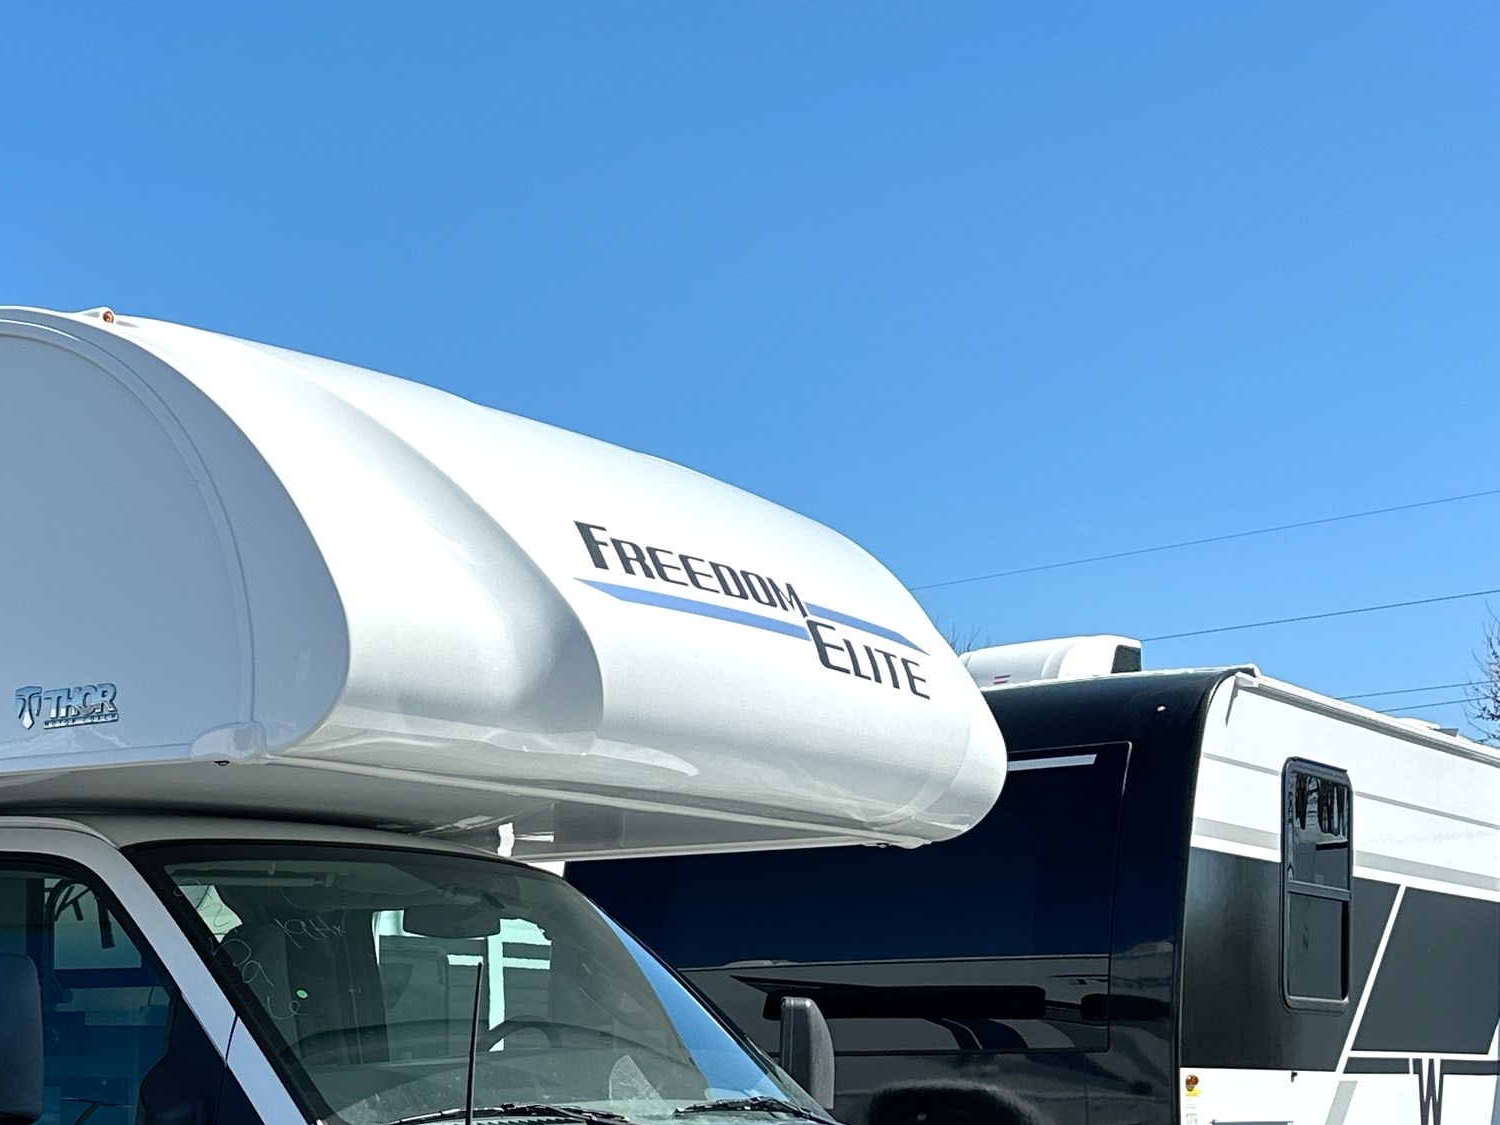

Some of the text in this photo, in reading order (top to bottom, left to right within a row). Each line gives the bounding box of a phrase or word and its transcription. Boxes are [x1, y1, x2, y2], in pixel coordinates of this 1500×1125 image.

[573, 519, 809, 619] FREEDOM
[806, 618, 931, 700] ELITE
[43, 682, 118, 720] THOR
